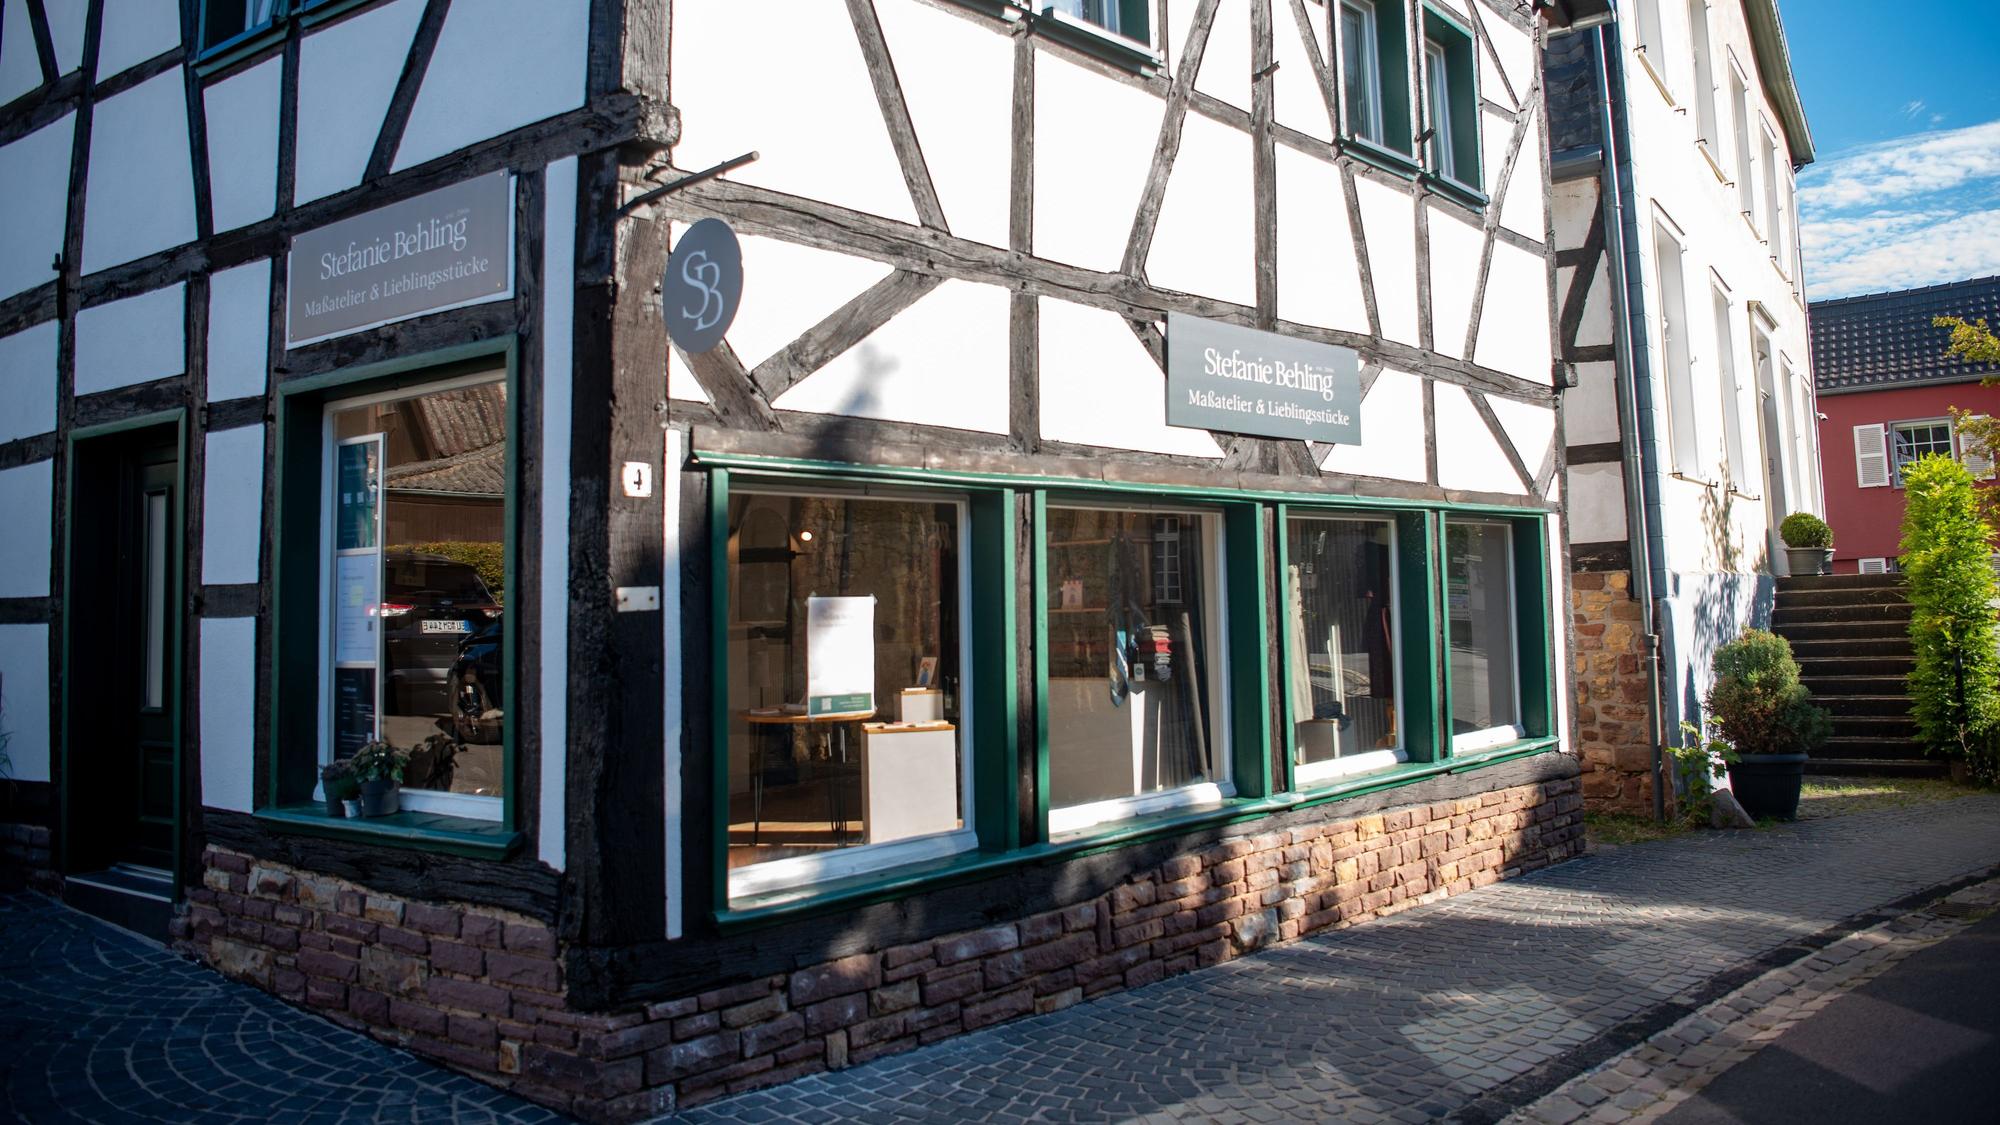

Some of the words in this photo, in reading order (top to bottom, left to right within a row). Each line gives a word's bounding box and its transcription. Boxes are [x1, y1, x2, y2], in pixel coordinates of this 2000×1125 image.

[320, 237, 390, 281] Stefanie
[394, 217, 468, 259] Behling
[304, 287, 367, 318] Maßatelier
[370, 283, 380, 301] &
[383, 256, 489, 297] Lieblingsstücke
[1204, 347, 1272, 384] Stefanie
[1275, 360, 1334, 402] Behling
[1188, 389, 1252, 413] Maßatelier
[1255, 399, 1265, 415] &
[1268, 400, 1350, 426] Lieblingsstücke
